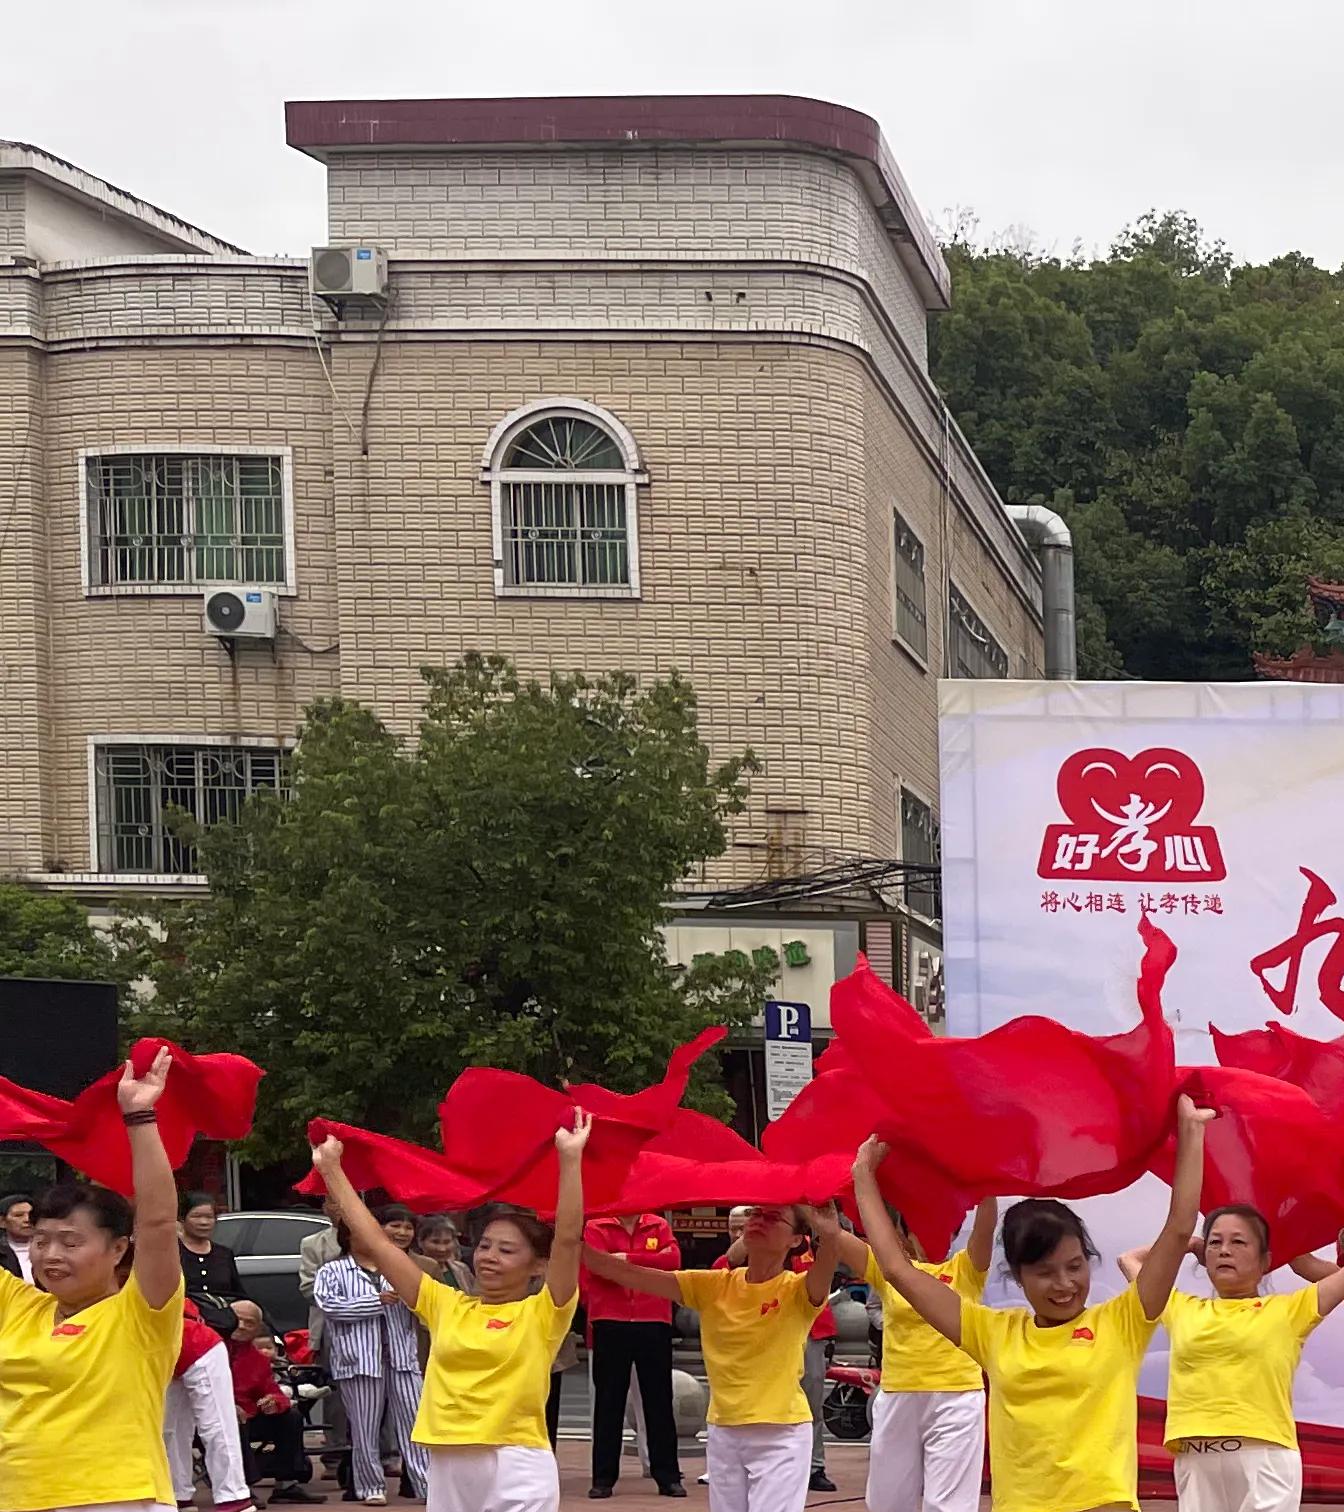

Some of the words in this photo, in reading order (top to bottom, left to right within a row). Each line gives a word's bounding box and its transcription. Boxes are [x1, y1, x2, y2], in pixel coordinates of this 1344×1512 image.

[1052, 793, 1211, 872] 好孝心
[1041, 890, 1127, 914] 将心相连
[1138, 891, 1224, 915] 让孝传递
[777, 1005, 799, 1038] P
